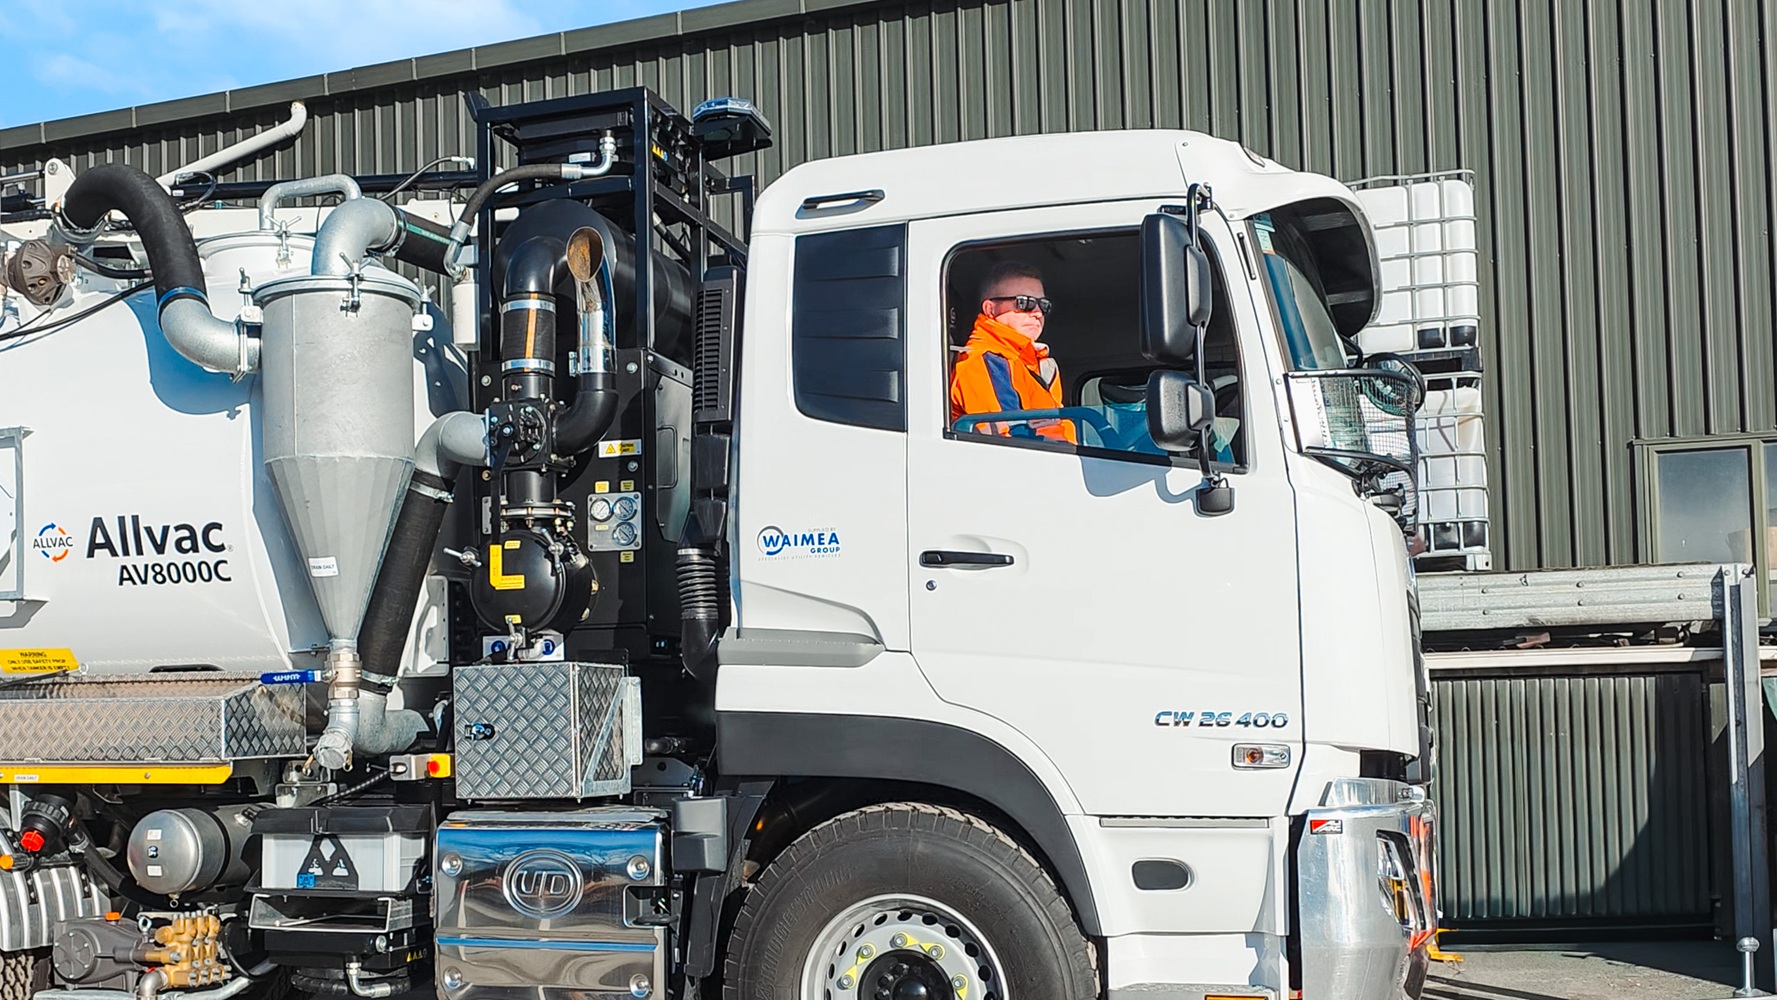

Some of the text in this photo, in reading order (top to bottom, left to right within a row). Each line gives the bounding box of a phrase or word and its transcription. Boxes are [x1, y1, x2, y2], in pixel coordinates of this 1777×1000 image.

[32, 536, 74, 550] ALLVAC
[86, 514, 226, 559] Allvac
[762, 532, 840, 548] WAIMEA
[810, 546, 841, 554] GROUP
[118, 559, 232, 586] AV8000C
[1154, 711, 1289, 729] CW 26 400
[513, 870, 575, 898] UD
